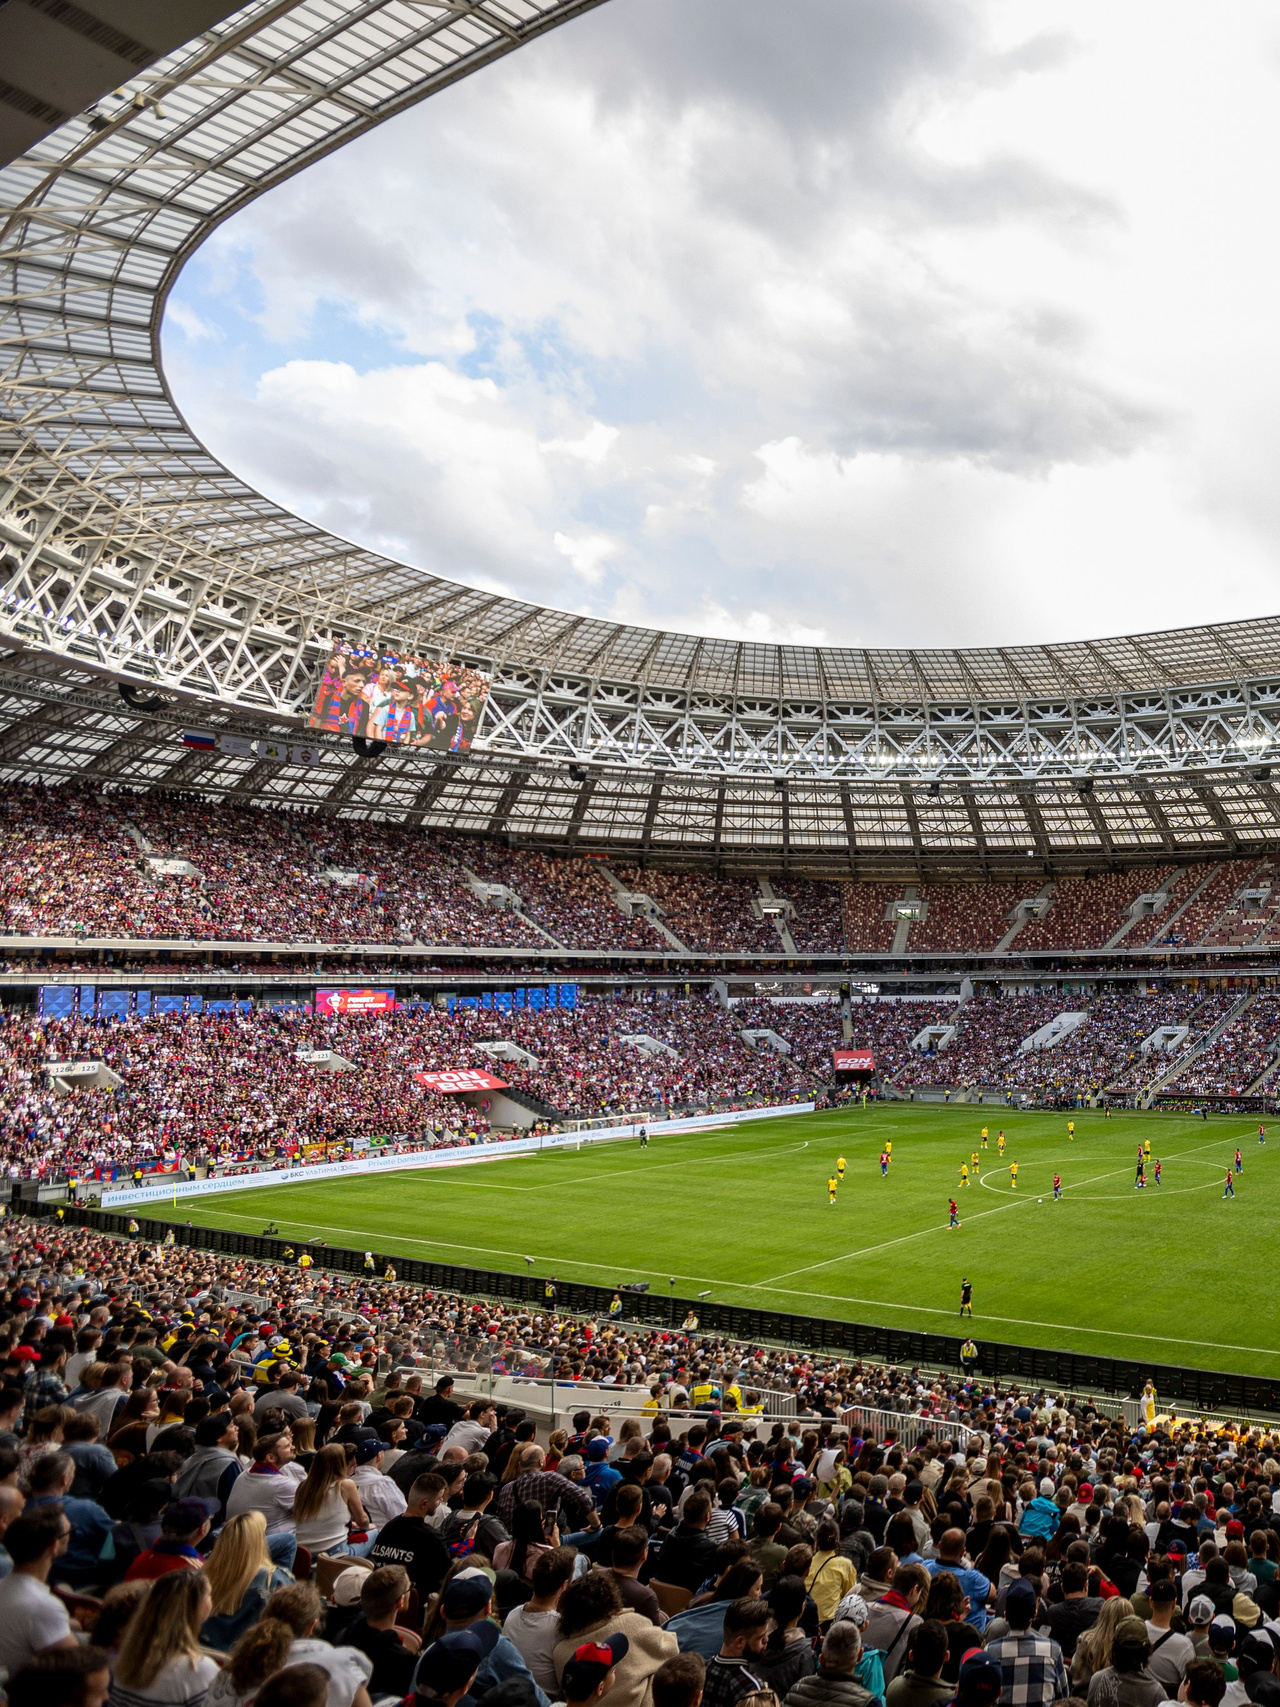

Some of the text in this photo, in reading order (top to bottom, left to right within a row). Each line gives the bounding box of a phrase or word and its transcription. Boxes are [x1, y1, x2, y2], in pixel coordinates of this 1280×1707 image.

[423, 1071, 481, 1082] FON
[436, 1079, 490, 1091] BET
[368, 1158, 396, 1168] Private
[397, 1154, 428, 1164] banking
[290, 1170, 304, 1179] БКС
[305, 1167, 338, 1177] УЛЬТИМА
[202, 1179, 245, 1190] сердцем
